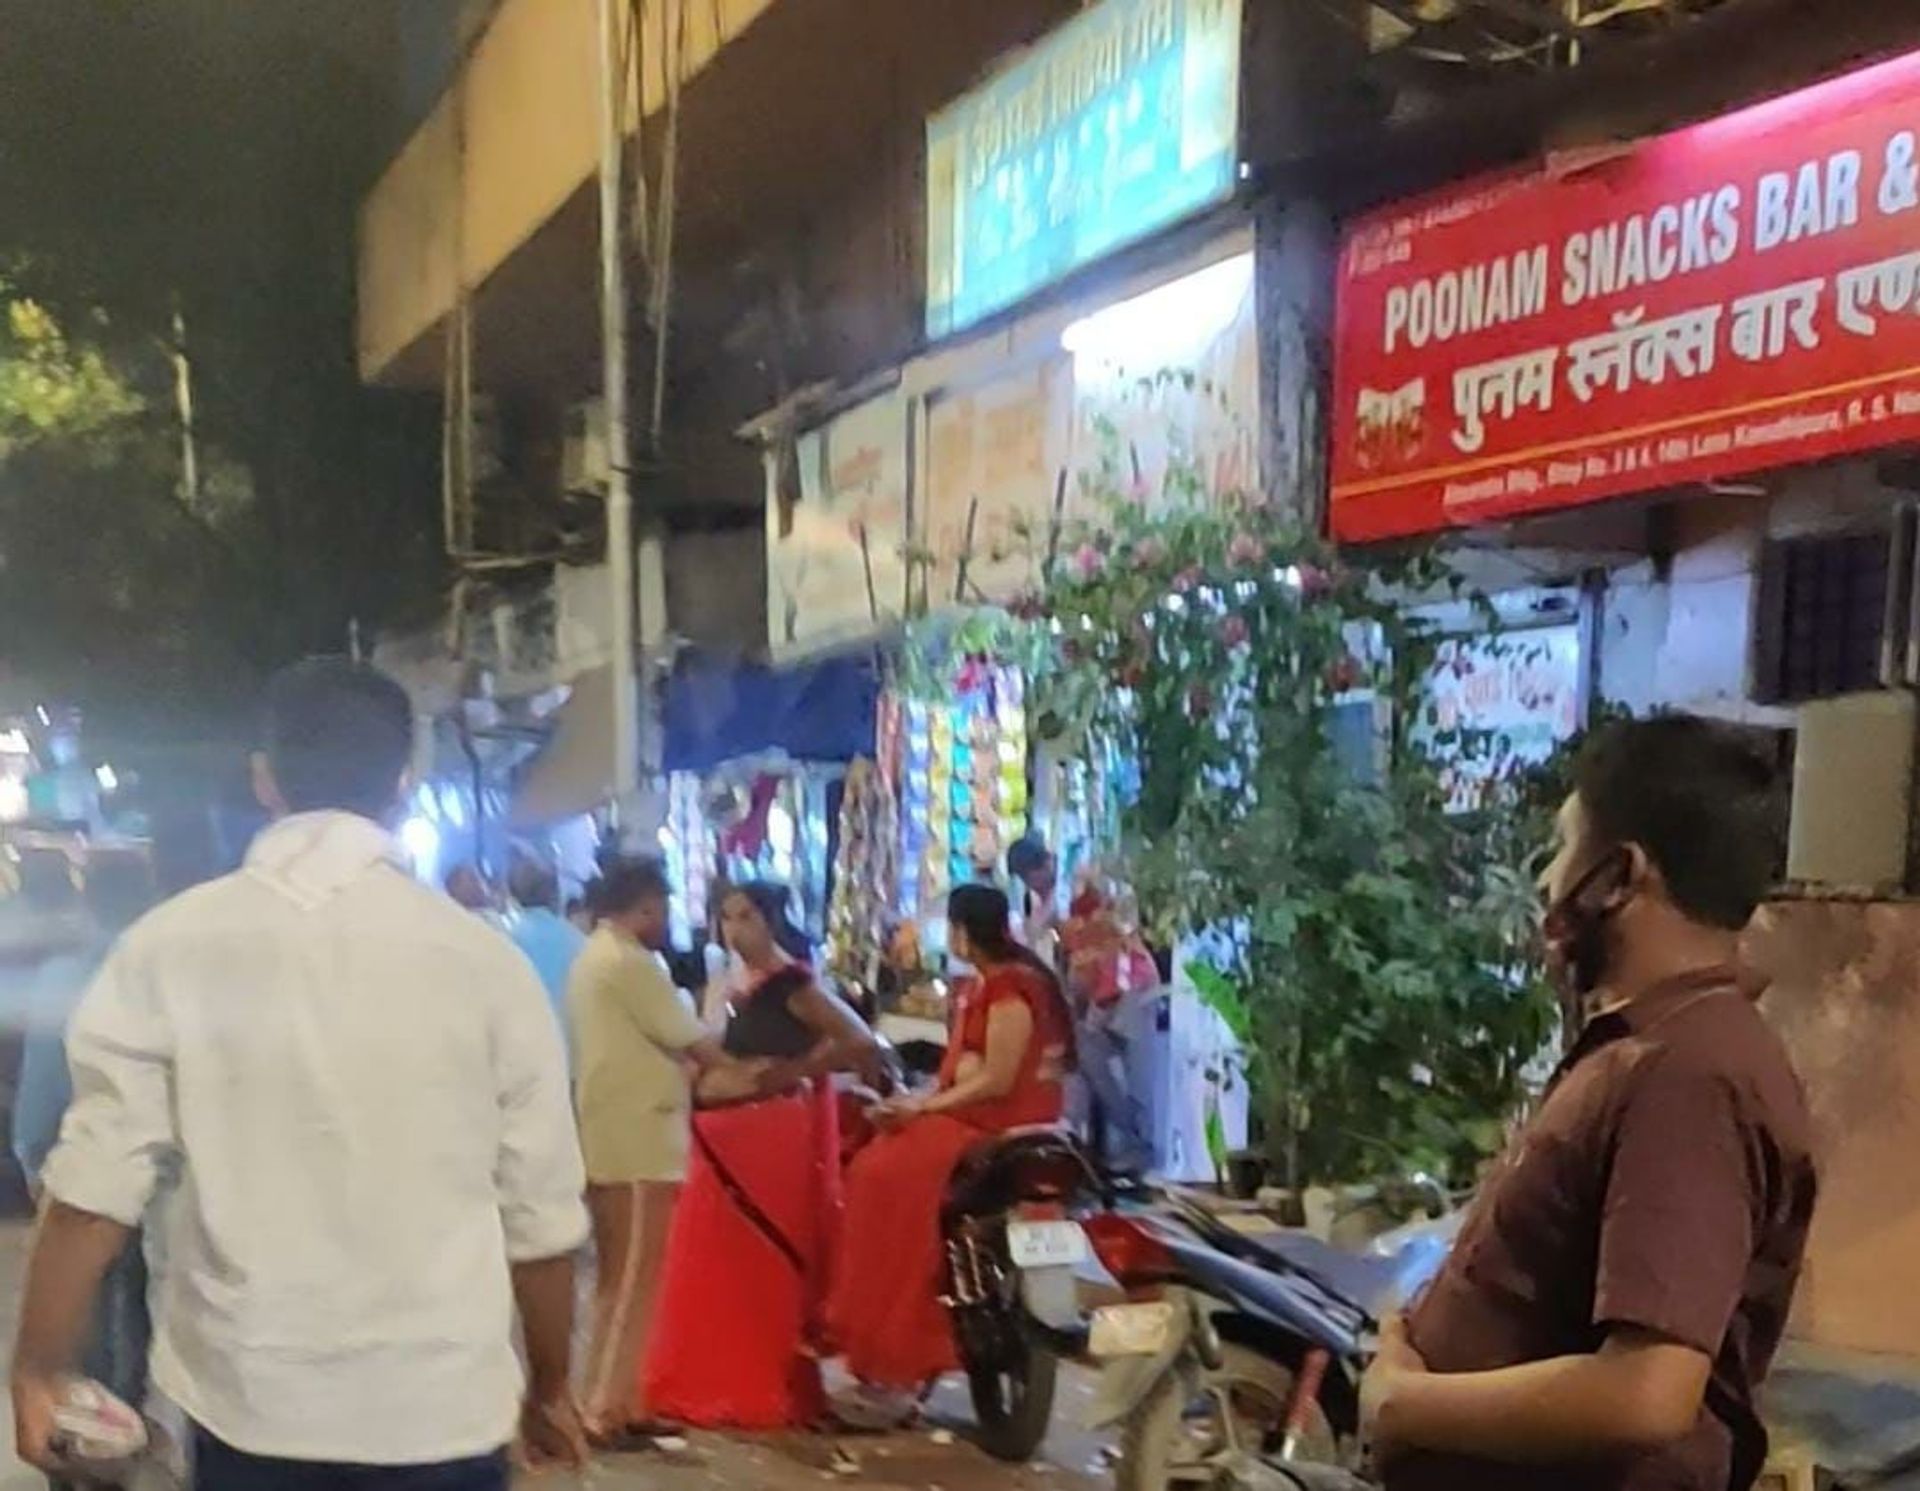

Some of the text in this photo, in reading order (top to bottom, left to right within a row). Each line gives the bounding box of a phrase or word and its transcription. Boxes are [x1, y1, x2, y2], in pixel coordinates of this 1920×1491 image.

[1384, 244, 1548, 355] POONAM
[1562, 183, 1740, 306] SNACKS
[1755, 150, 1860, 253] BAR
[1878, 130, 1920, 214] &
[1451, 347, 1559, 453] पुनम
[1731, 277, 1826, 362] बार
